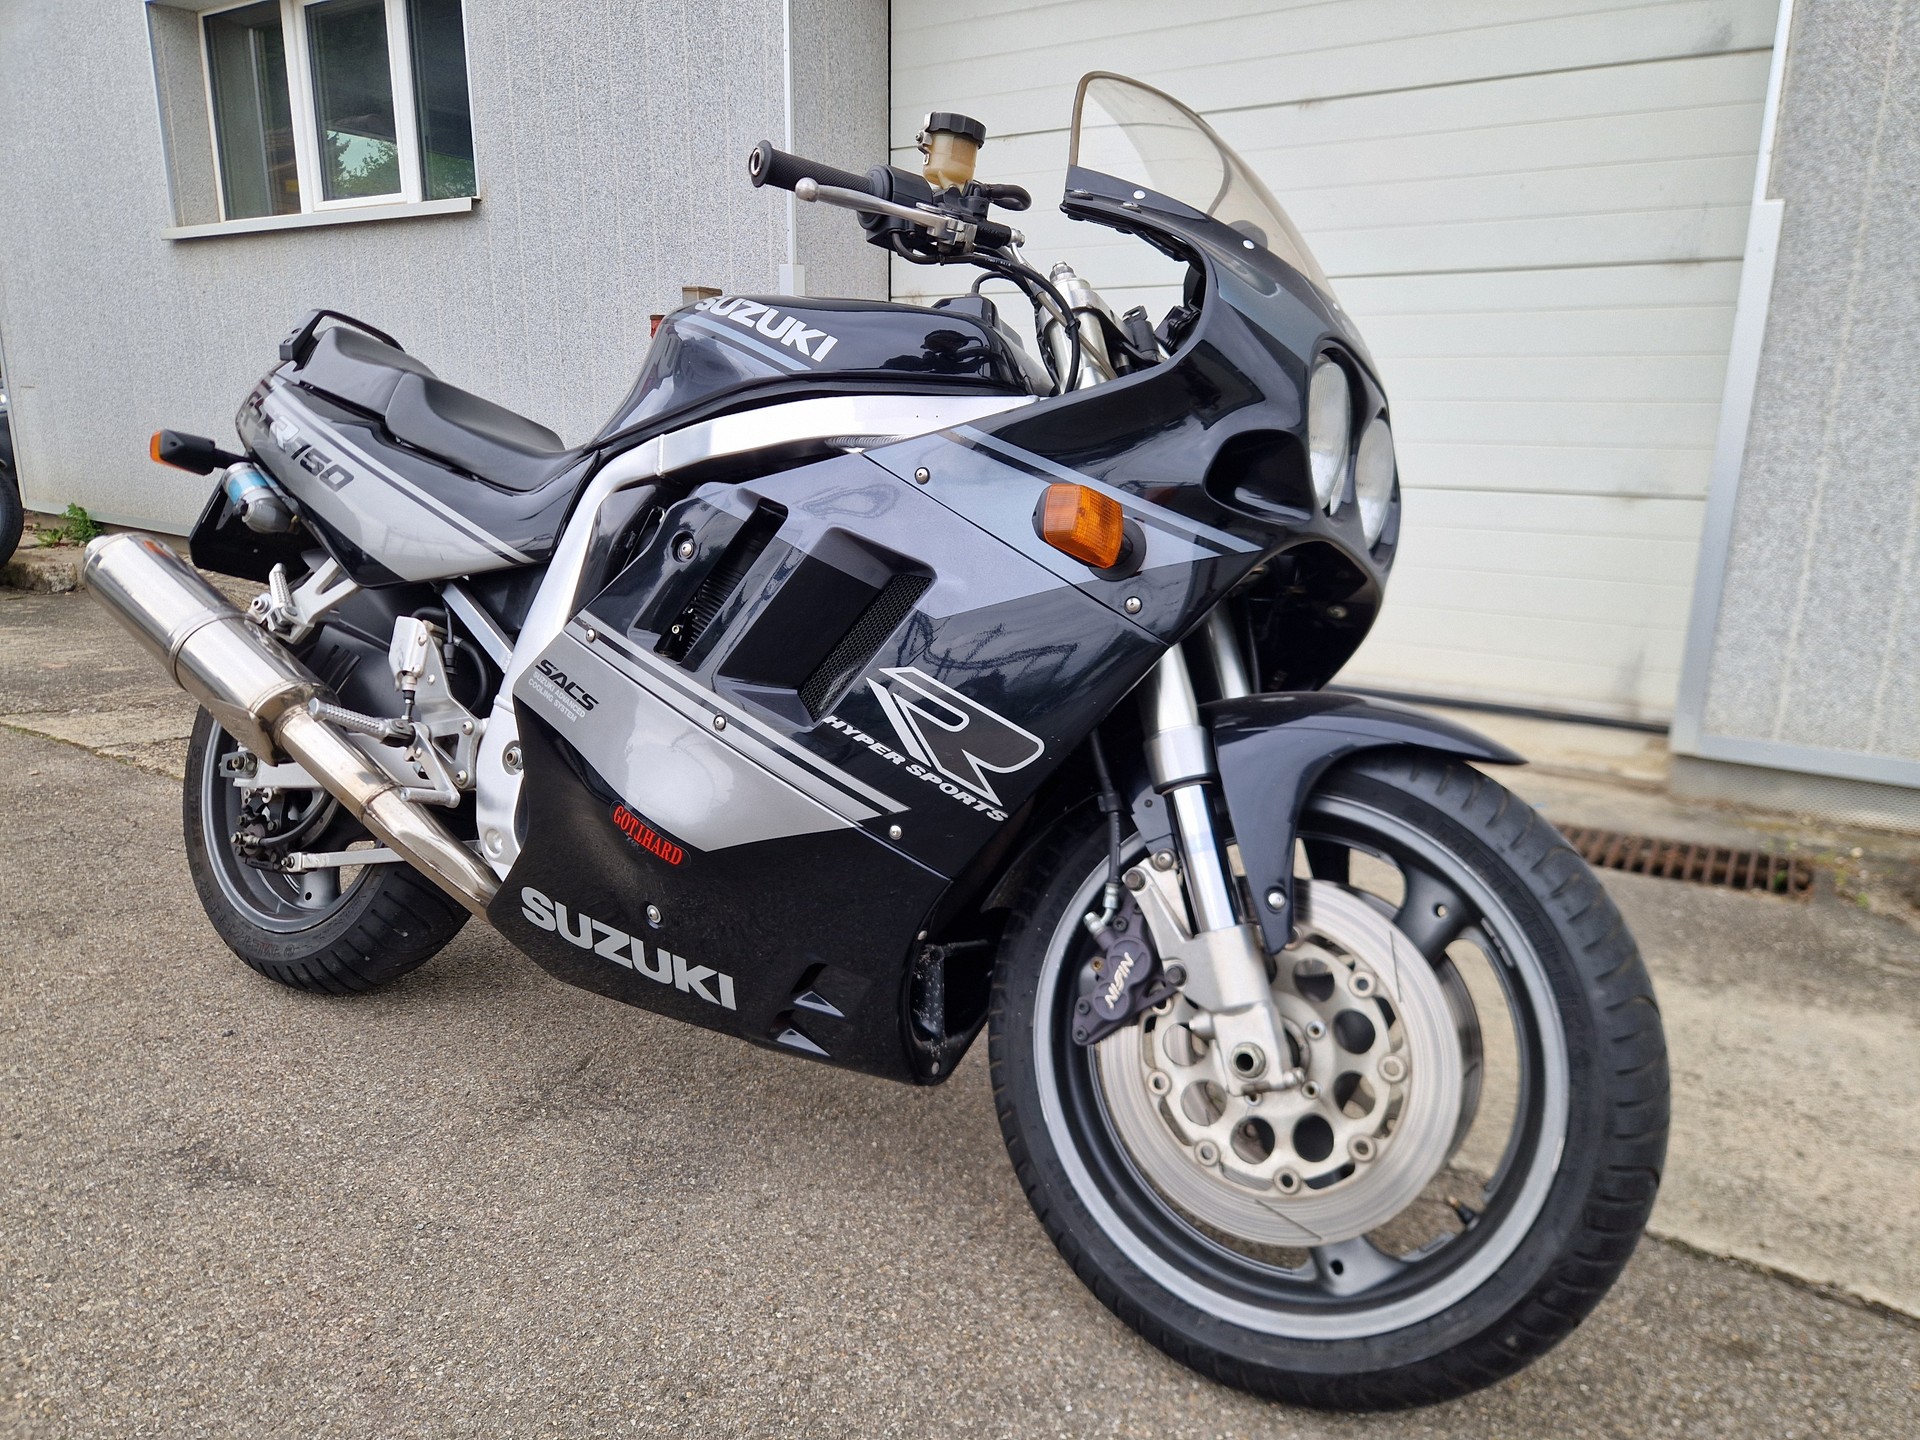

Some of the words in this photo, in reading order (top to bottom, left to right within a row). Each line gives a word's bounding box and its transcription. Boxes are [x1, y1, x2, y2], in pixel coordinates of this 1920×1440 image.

[695, 297, 838, 362] SUZUKI
[528, 678, 554, 703] COOLING
[553, 699, 578, 723] SYSTEM
[533, 671, 556, 693] SUZUKI
[554, 690, 586, 718] ADVANCED
[535, 659, 600, 711] SACS
[866, 667, 1045, 807] R
[822, 715, 906, 766] HYPER
[905, 764, 1009, 822] SPORTS
[521, 886, 737, 1011] SUZUKI
[1104, 951, 1135, 1010] NISSIN
